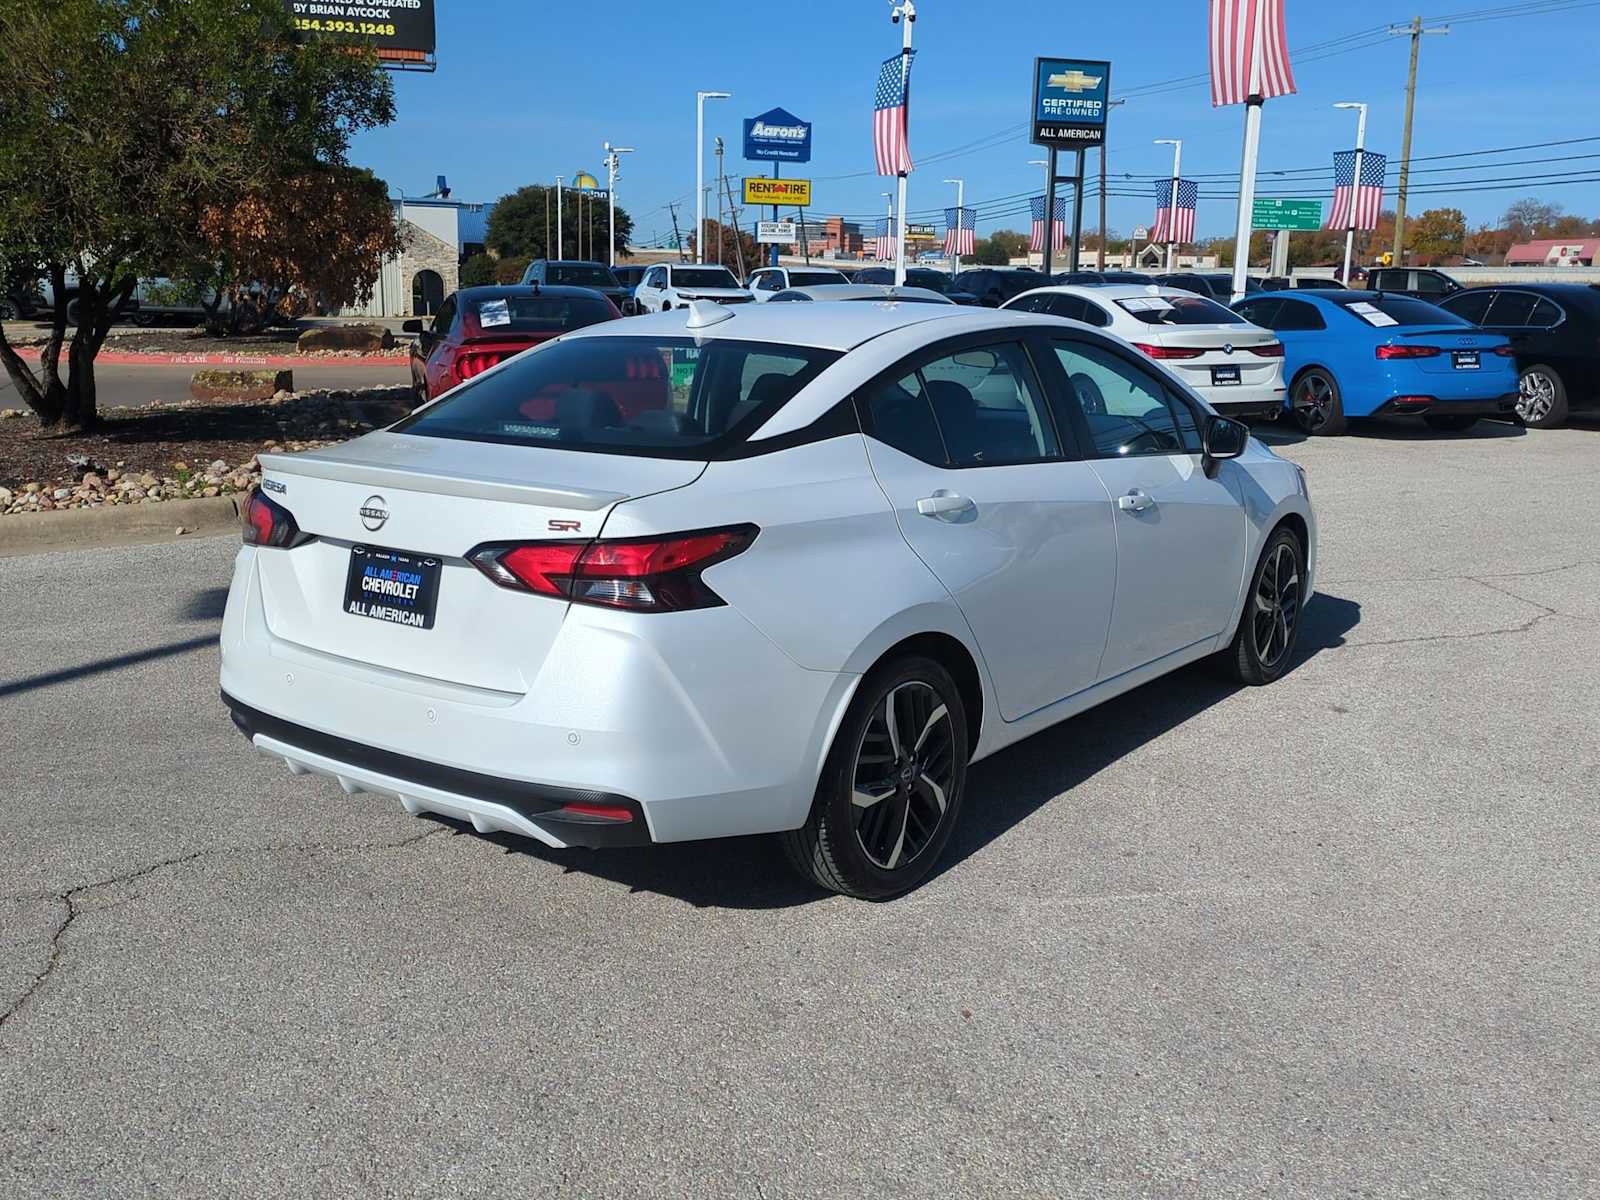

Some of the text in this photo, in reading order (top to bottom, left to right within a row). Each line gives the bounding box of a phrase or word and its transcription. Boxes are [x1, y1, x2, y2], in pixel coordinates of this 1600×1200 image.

[366, 0, 421, 9] OPERATED
[293, 3, 391, 19] BY BRIAN AYCOCK
[1042, 98, 1102, 109] CERTIFIED
[1044, 107, 1100, 117] PRE-OWNED
[750, 120, 808, 139] Aaron's
[1040, 127, 1101, 139] ALL AMERICAN
[749, 183, 775, 193] RENT
[784, 184, 807, 194] TIRE
[359, 507, 390, 520] NISSAN
[548, 520, 581, 532] SR
[364, 566, 422, 585] ALL AMERICAN
[361, 575, 419, 600] CHEVROLET
[348, 600, 425, 627] ALL AMERICAN
